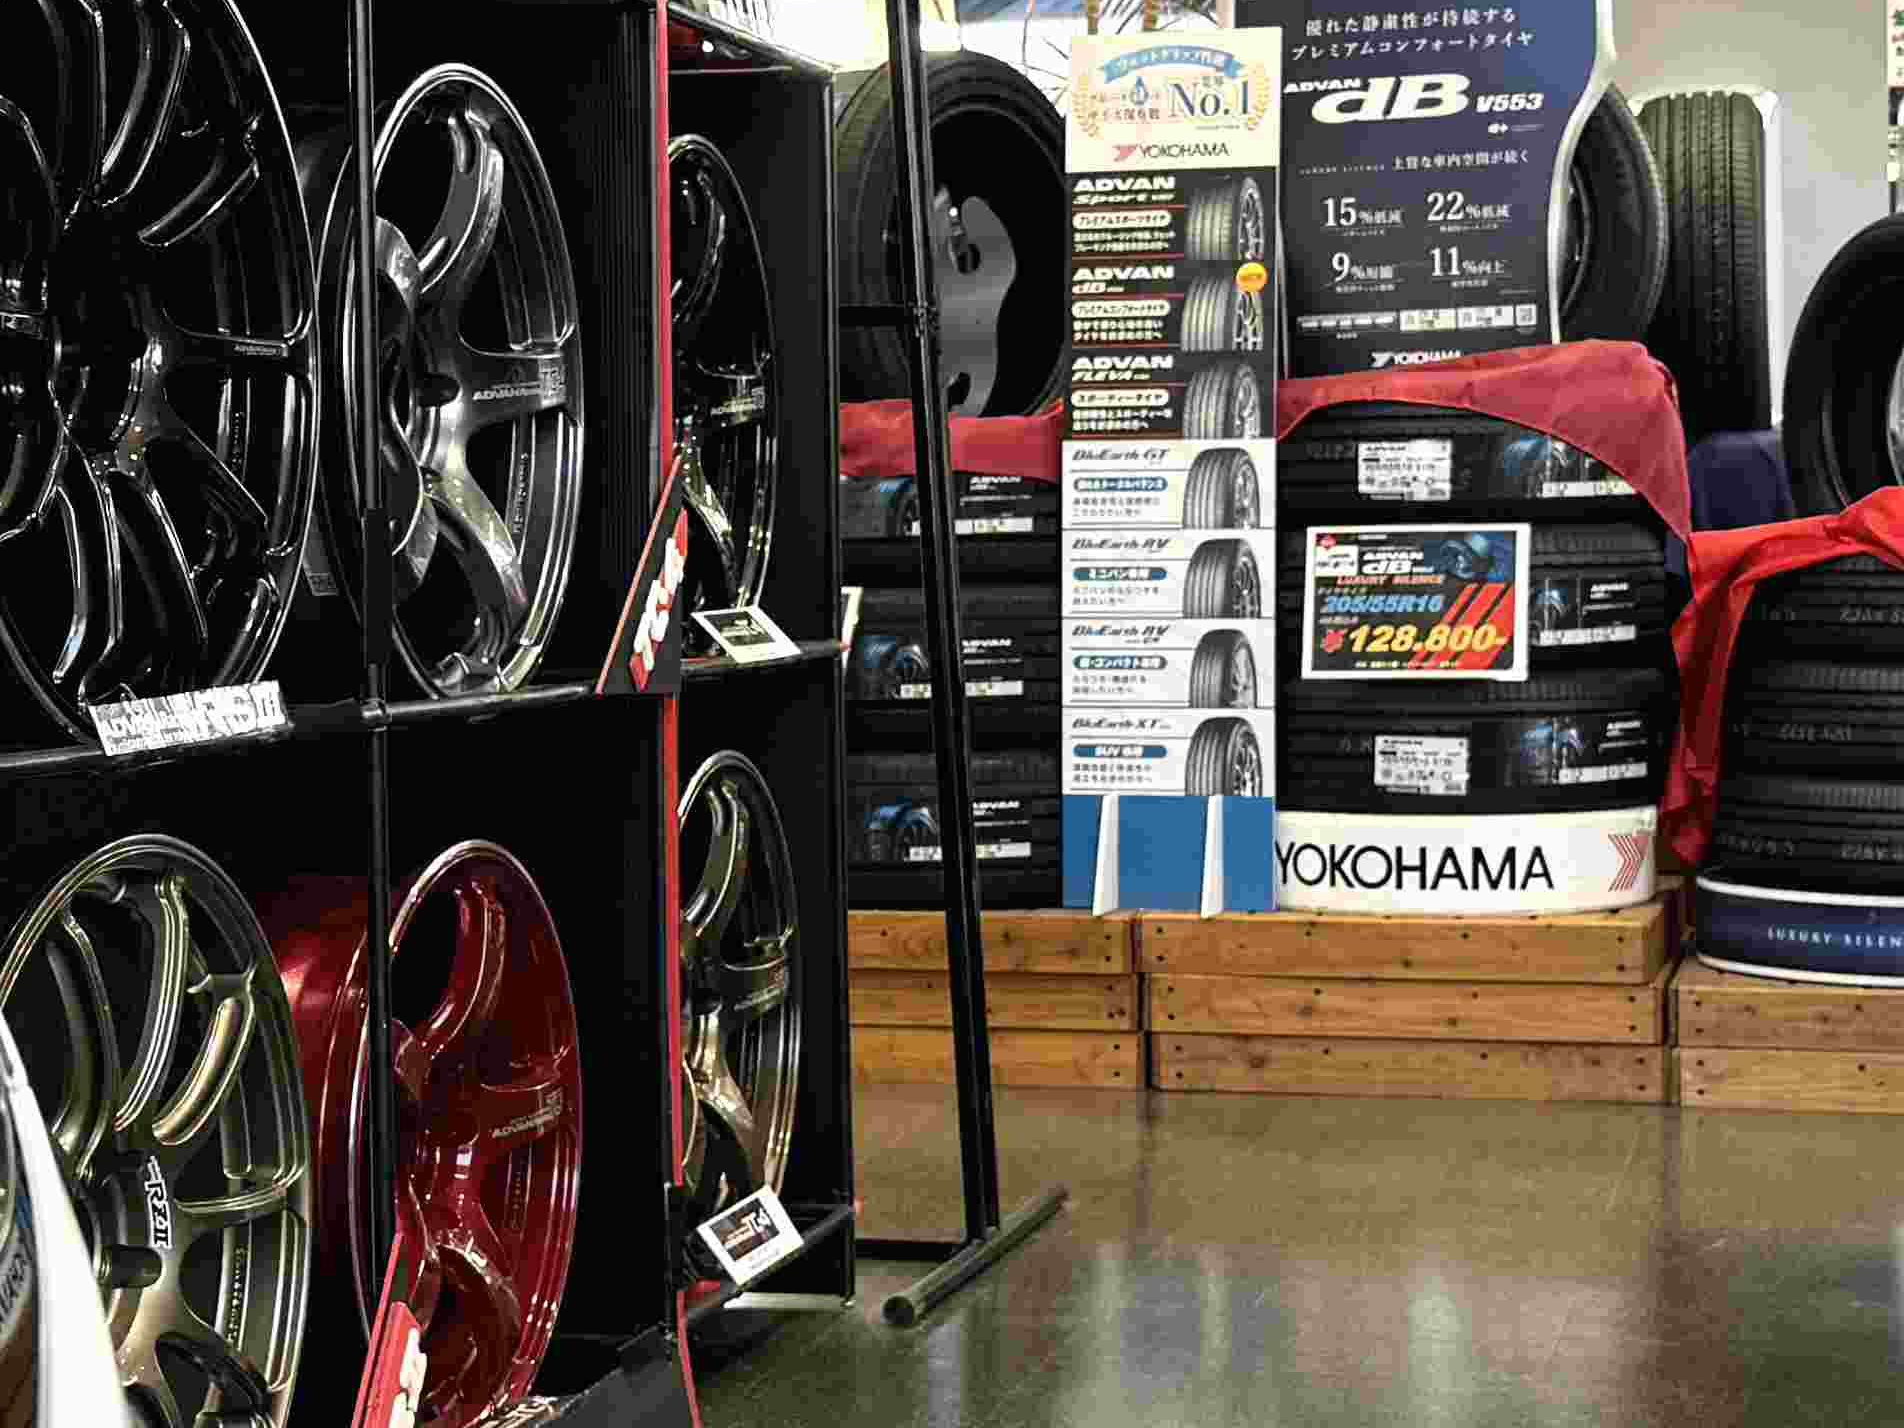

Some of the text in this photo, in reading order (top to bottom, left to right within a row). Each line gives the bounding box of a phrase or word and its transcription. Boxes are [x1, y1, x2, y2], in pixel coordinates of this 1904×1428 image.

[1283, 73, 1544, 124] ADVAN dB V553
[1138, 142, 1230, 160] YOKOHAMA
[1072, 176, 1175, 192] ADVAN
[1072, 265, 1175, 281] ADVAN
[1072, 355, 1174, 371] ADVAN
[1274, 842, 1554, 892] YOKOHAMA
